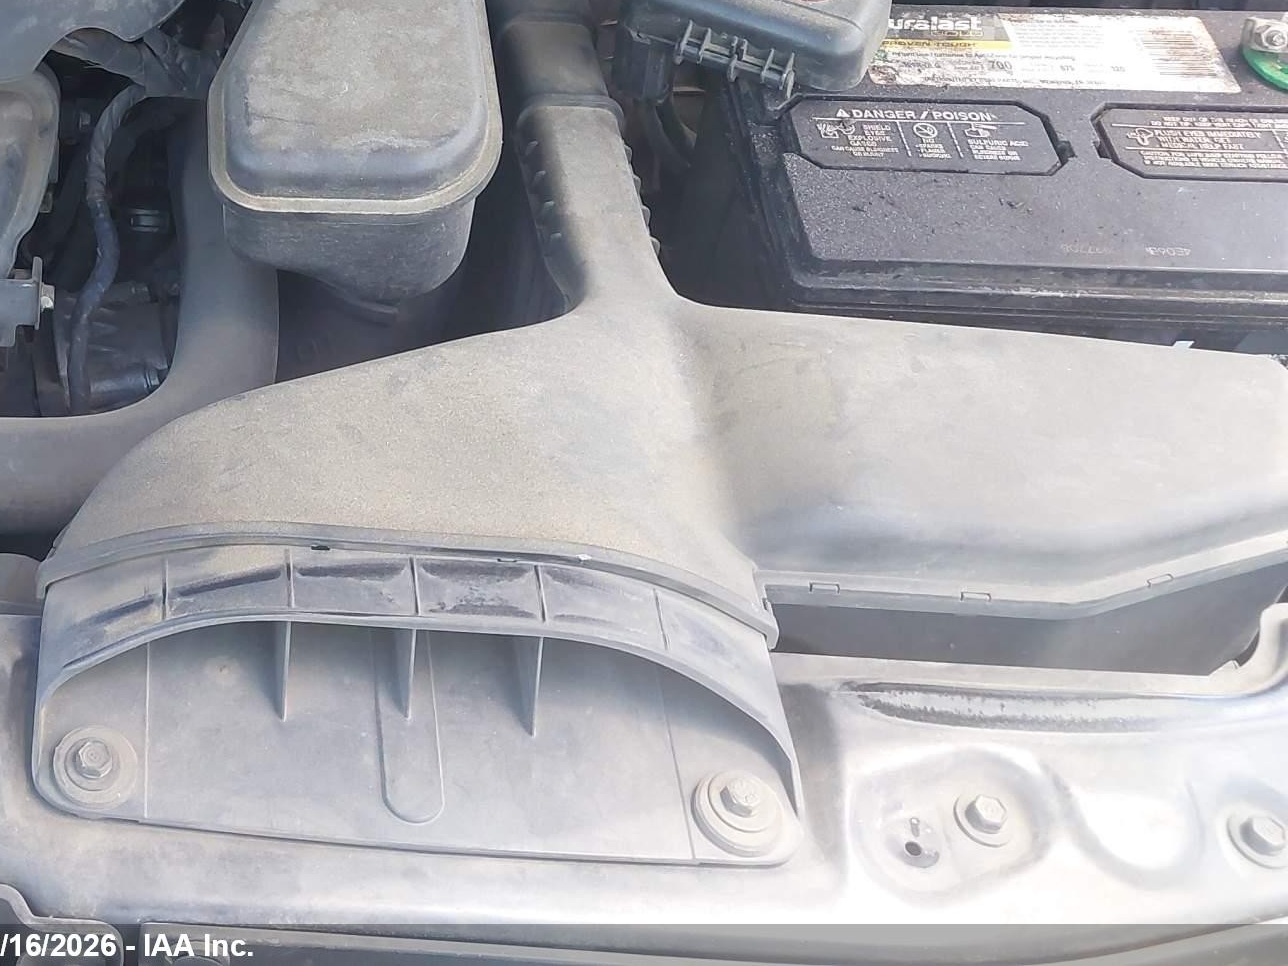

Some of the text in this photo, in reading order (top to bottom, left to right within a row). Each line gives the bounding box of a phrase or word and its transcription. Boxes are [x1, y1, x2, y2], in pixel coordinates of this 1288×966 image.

[887, 16, 983, 32] uralast
[852, 109, 992, 121] DANGER / POISON
